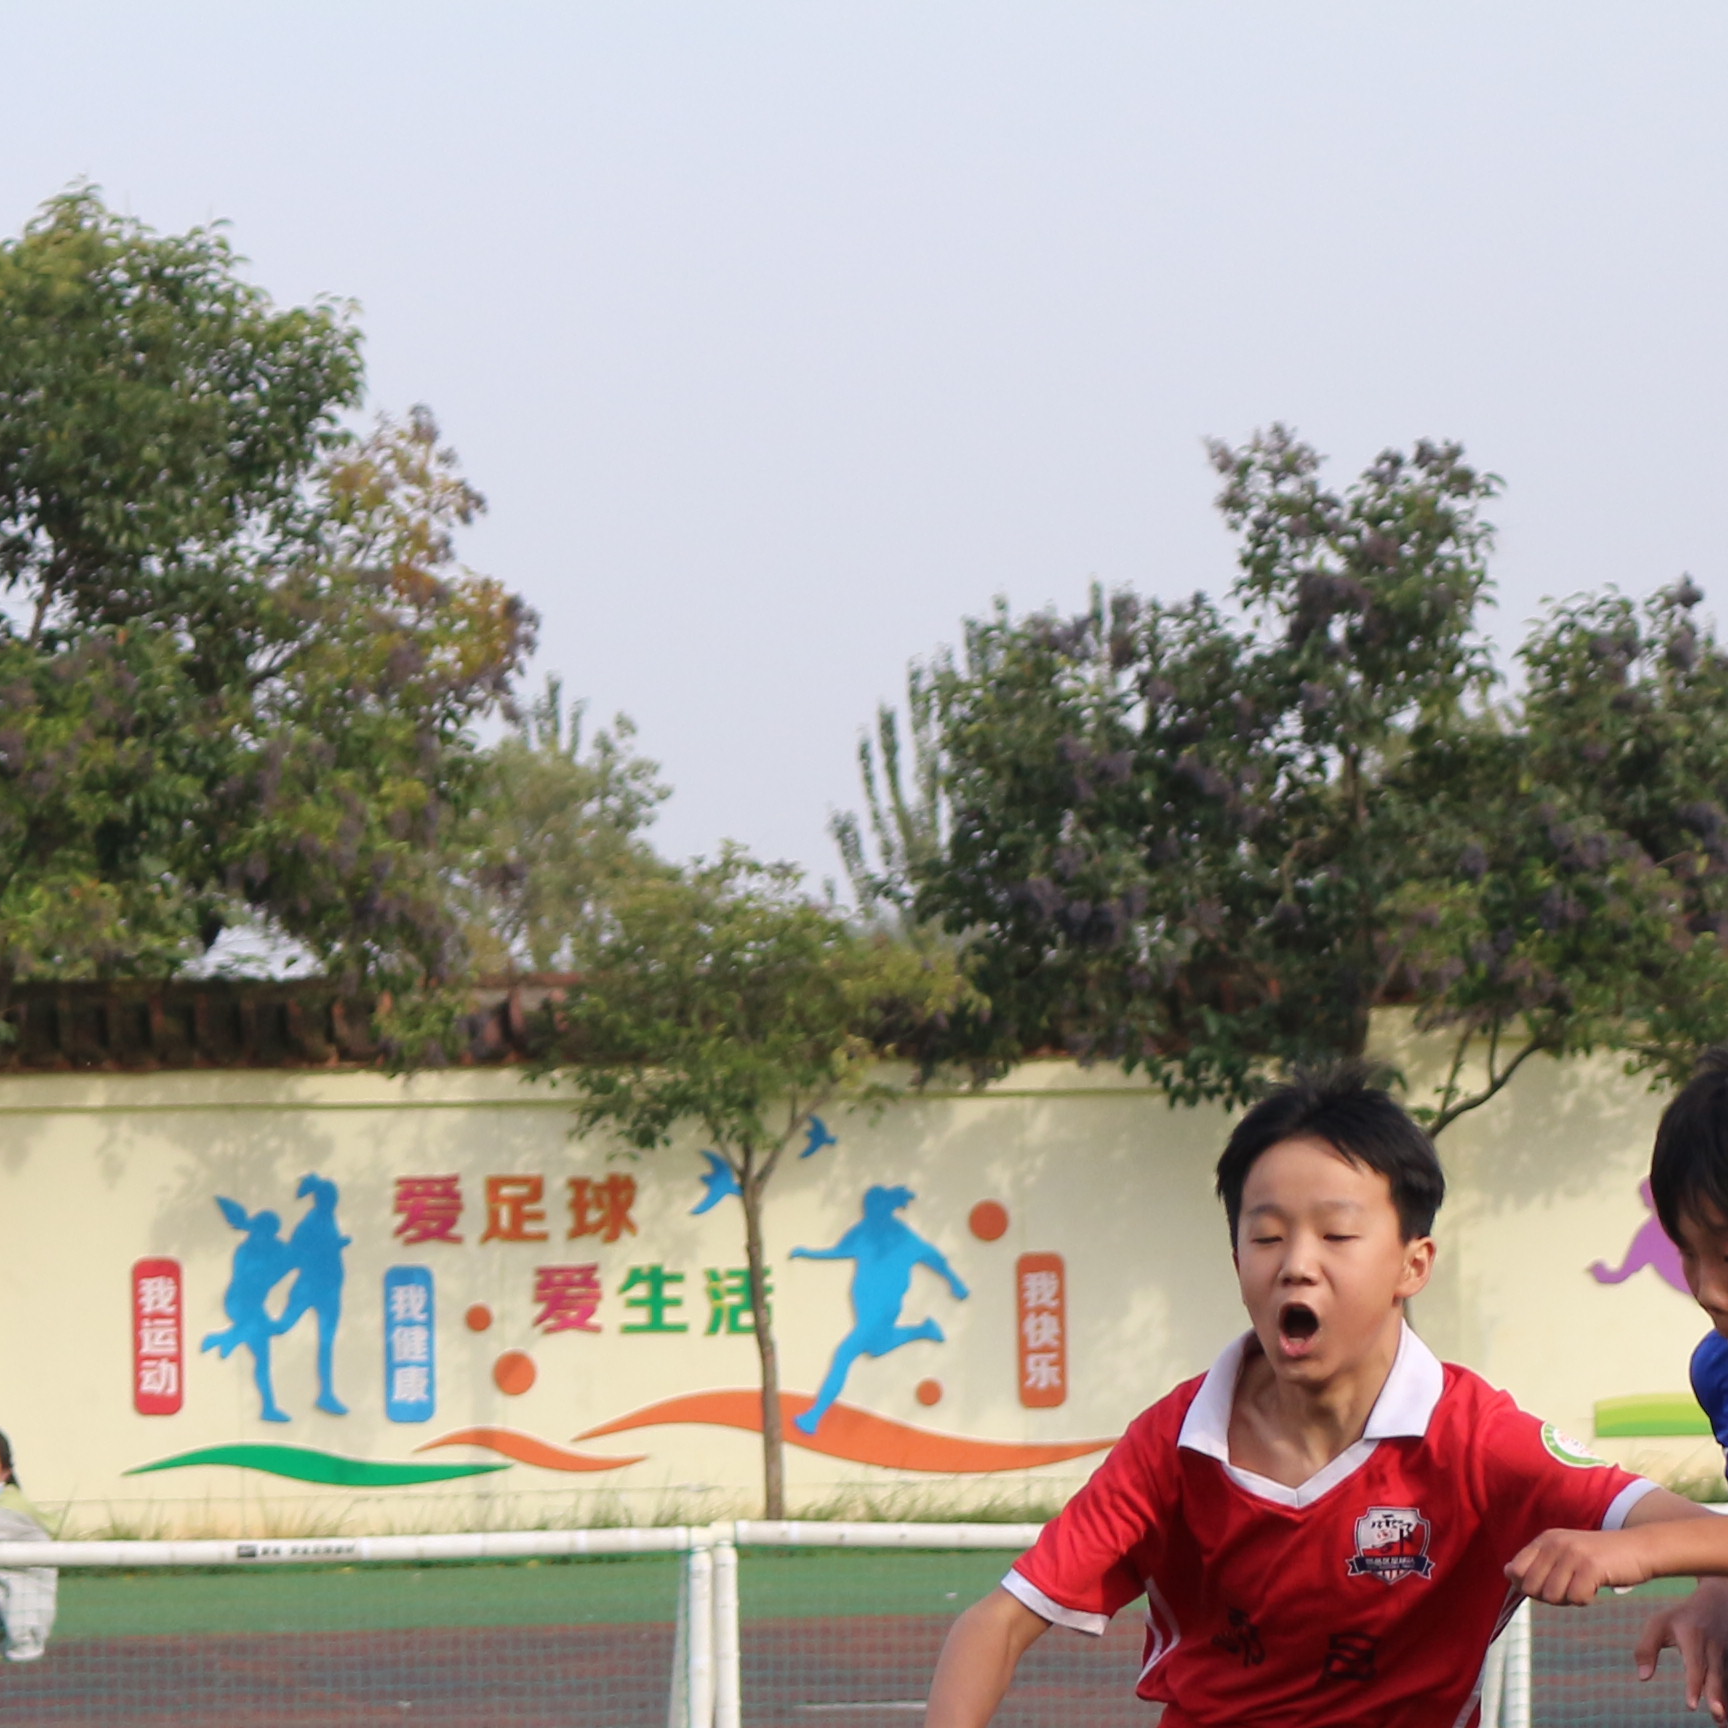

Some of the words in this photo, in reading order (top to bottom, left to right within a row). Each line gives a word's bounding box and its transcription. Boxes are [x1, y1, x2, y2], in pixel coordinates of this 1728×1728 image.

[393, 1173, 638, 1246] 爱足球
[138, 1275, 179, 1396] 我运动
[390, 1283, 430, 1402] 我健康
[532, 1262, 774, 1336] 爱生活
[1023, 1270, 1062, 1390] 我快乐
